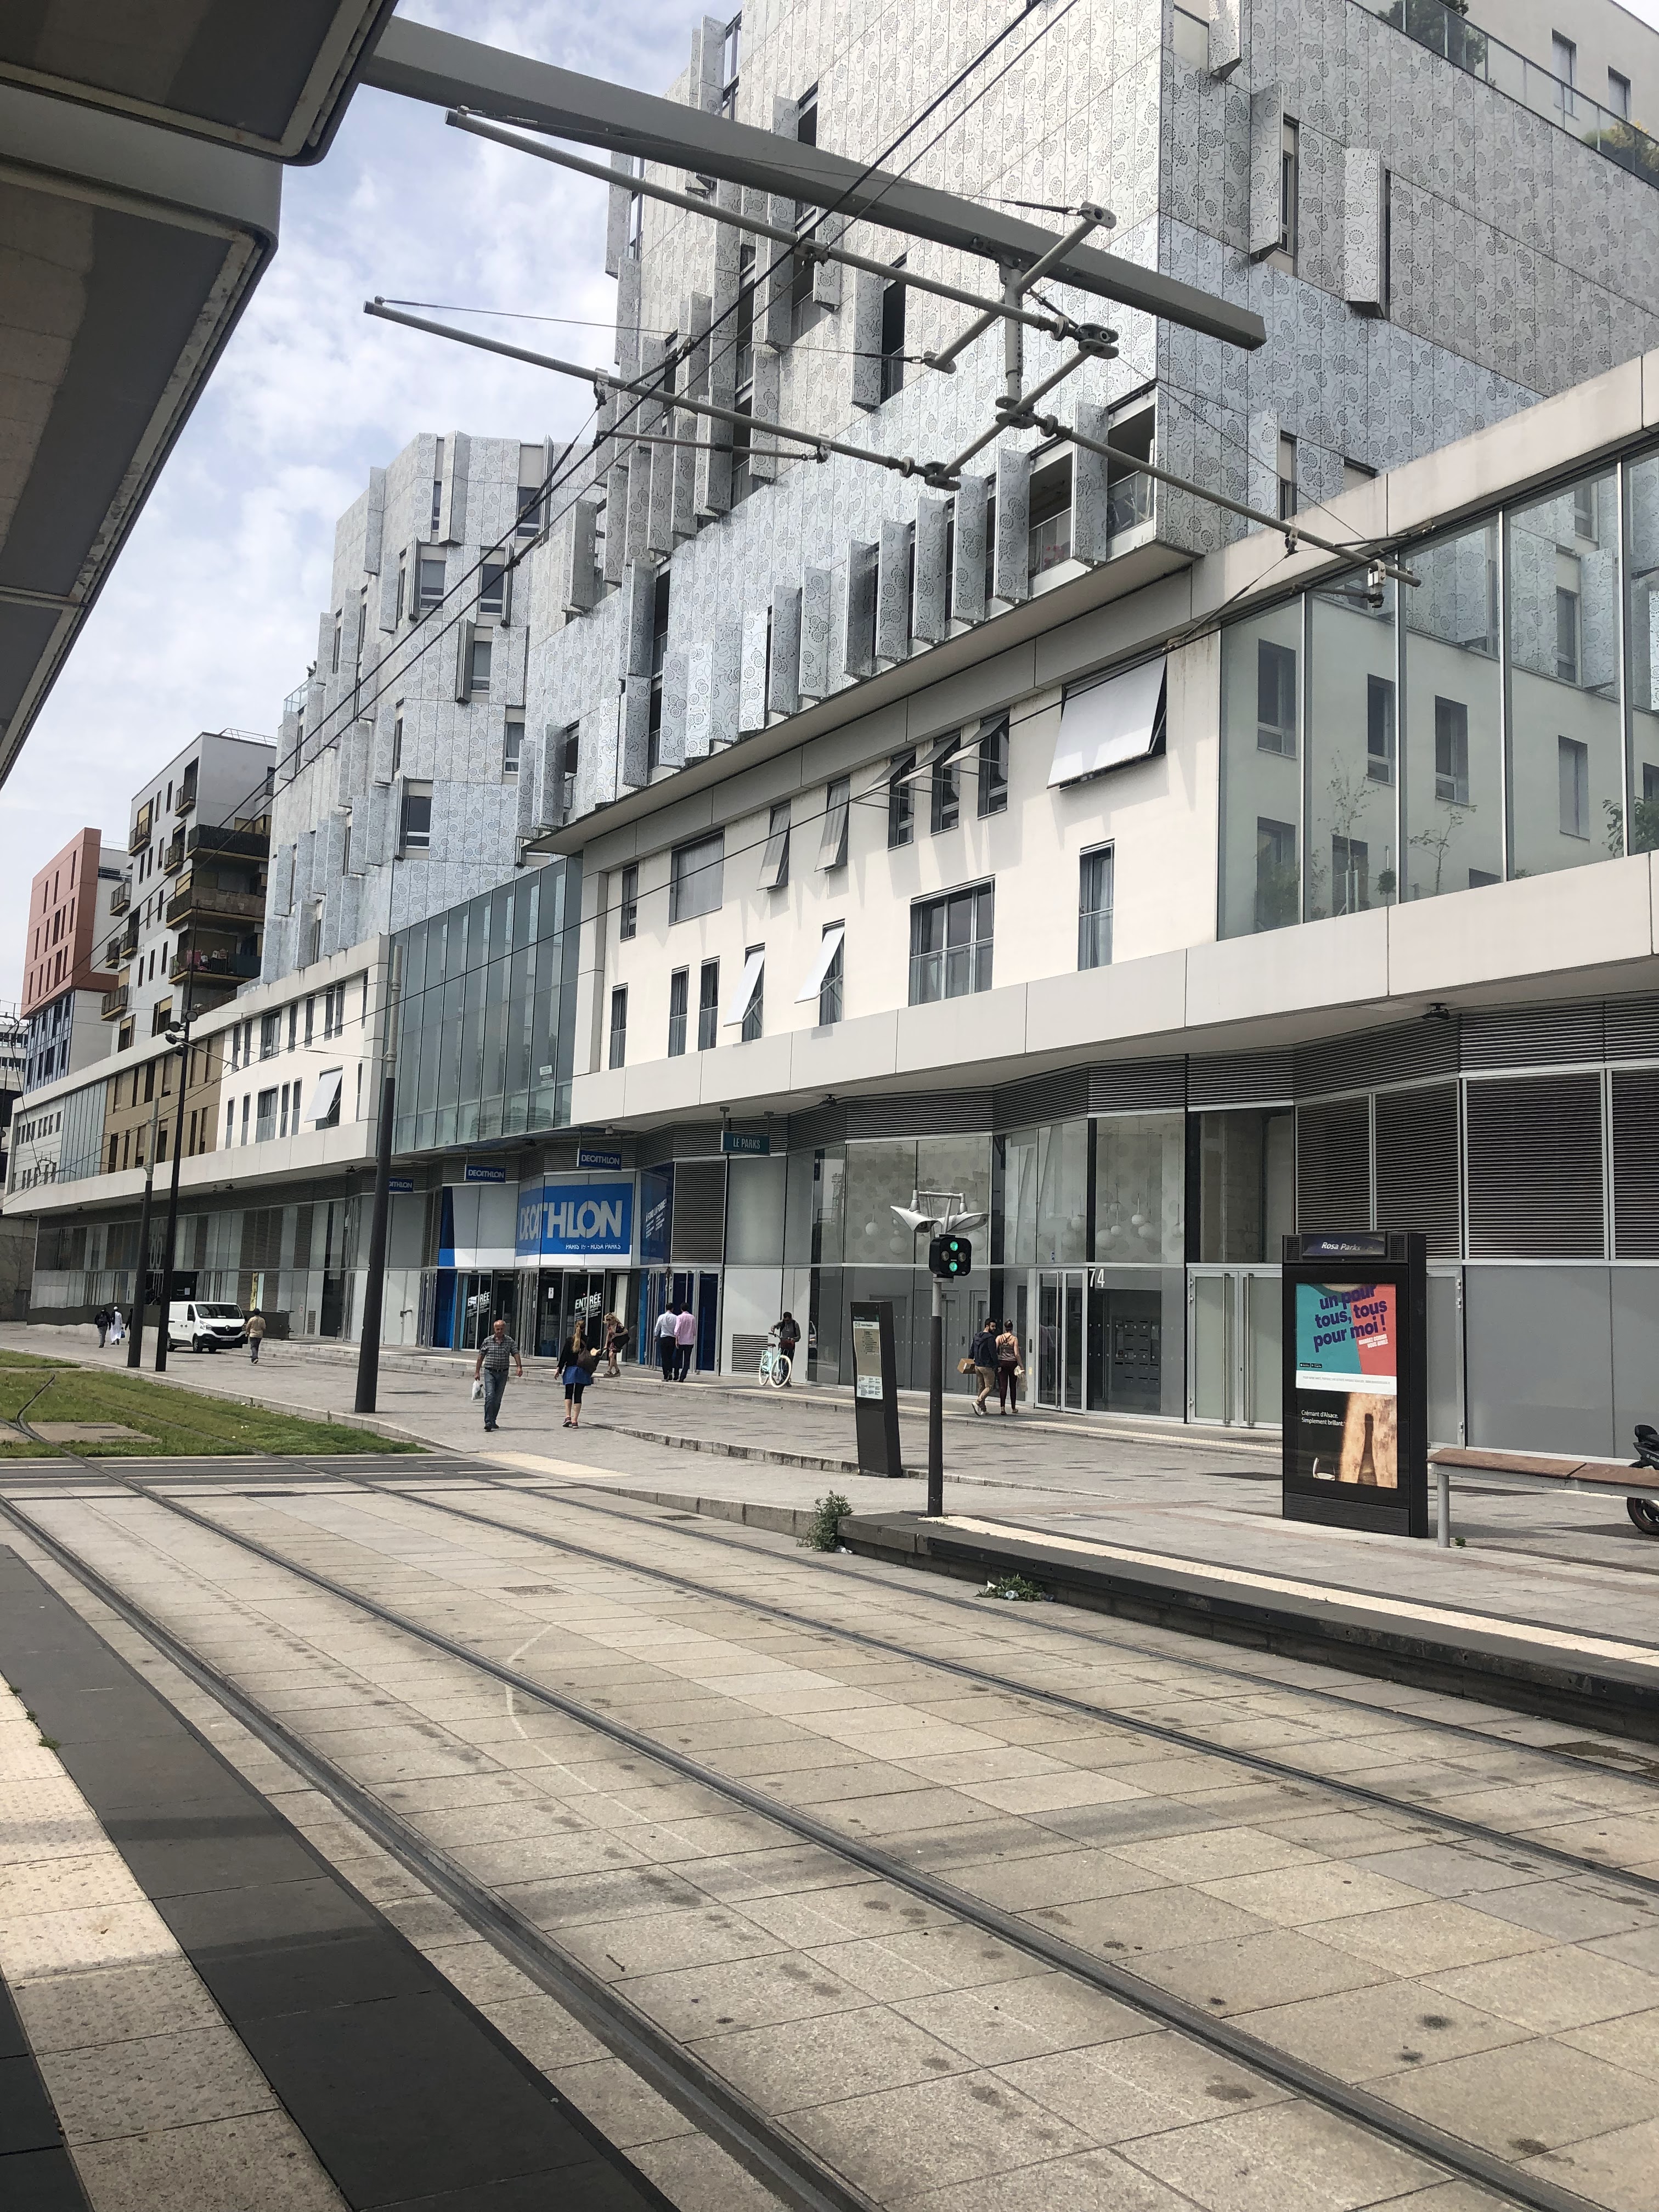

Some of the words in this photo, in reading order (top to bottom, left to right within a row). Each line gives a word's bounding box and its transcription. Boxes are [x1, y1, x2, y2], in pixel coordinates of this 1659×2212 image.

[733, 1137, 740, 1147] LE
[741, 1138, 760, 1149] PARKS
[582, 1154, 620, 1165] DECATHLON
[468, 1169, 505, 1178] DECATHLON
[519, 1200, 623, 1241] DECATHLON
[1321, 1242, 1339, 1250] Rosa
[1340, 1243, 1362, 1251] Parks
[1089, 1268, 1105, 1288] 74
[575, 1291, 602, 1310] ENTRÉE
[1319, 1295, 1339, 1310] un
[1341, 1284, 1378, 1310] pour
[1314, 1311, 1352, 1328] tous,
[1353, 1300, 1387, 1319] tous
[1313, 1328, 1347, 1353] pour
[1350, 1316, 1379, 1339] moi
[1380, 1314, 1386, 1331] !
[1301, 1417, 1327, 1425] Simplement
